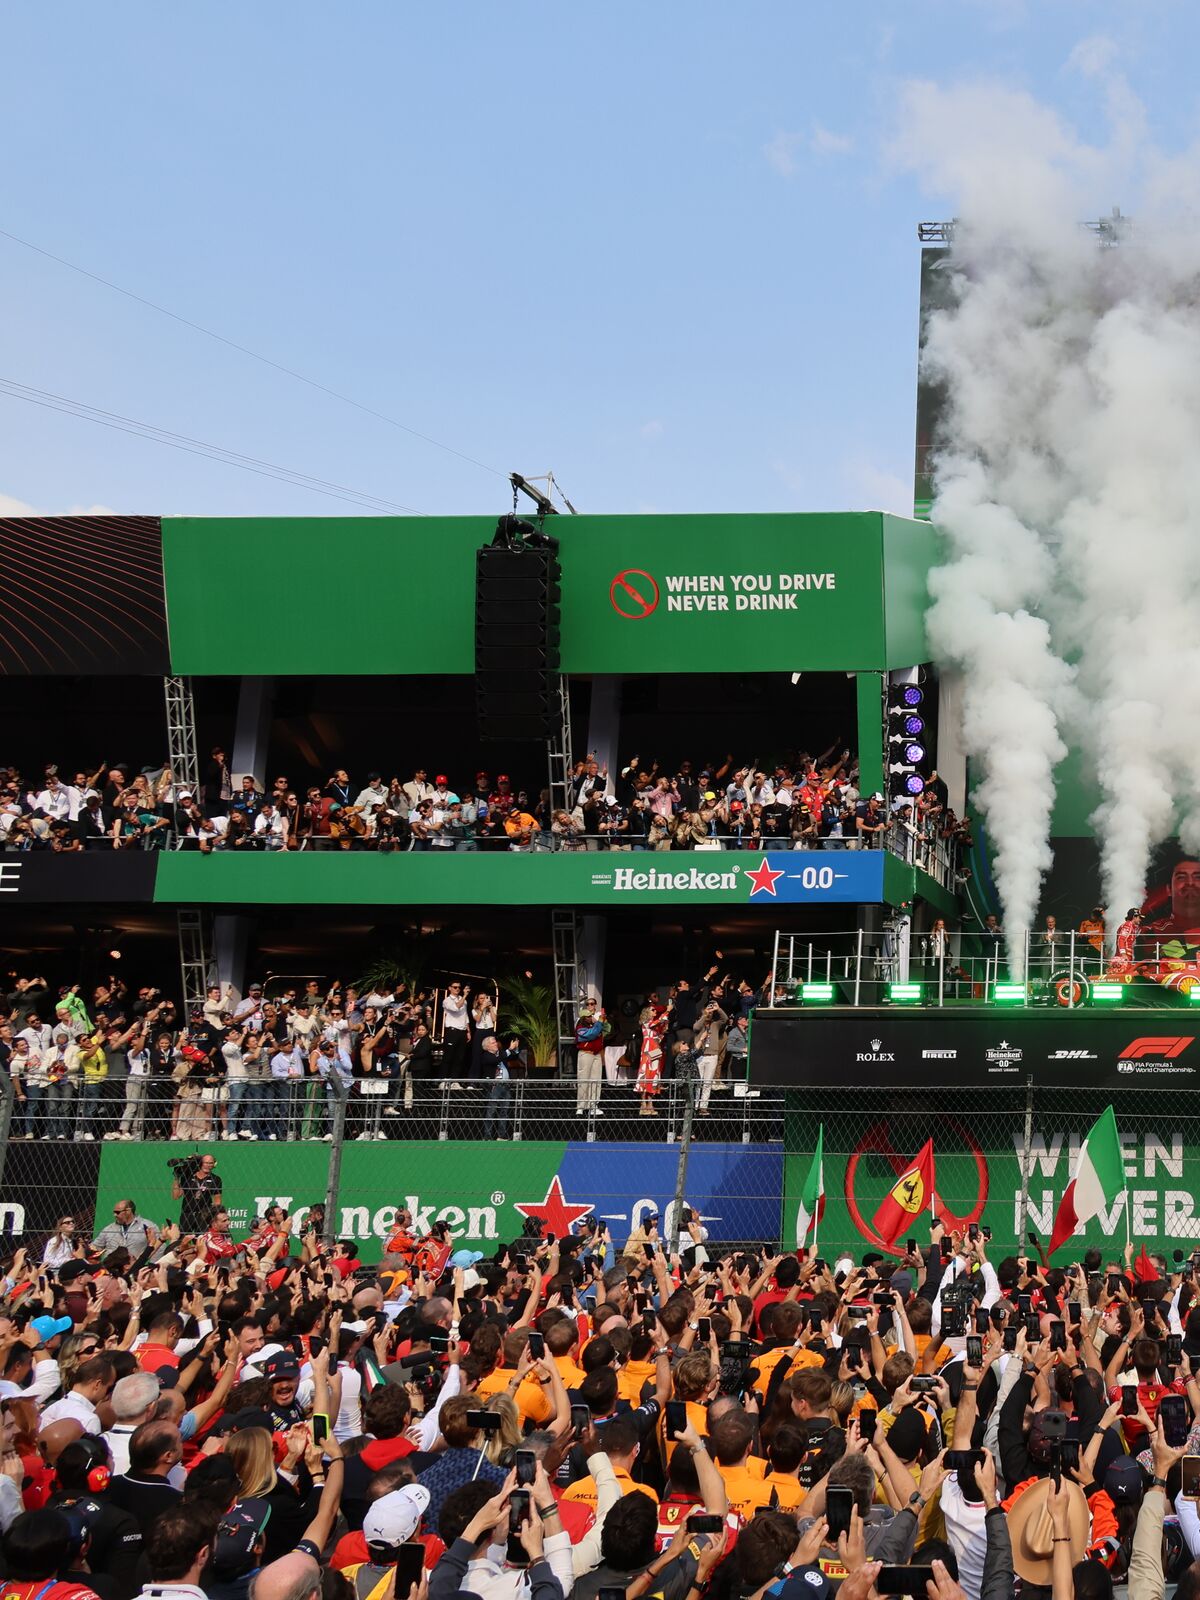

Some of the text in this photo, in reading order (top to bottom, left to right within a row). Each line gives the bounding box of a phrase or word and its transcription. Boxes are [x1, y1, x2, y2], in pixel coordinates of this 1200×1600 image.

[665, 573, 836, 592] WHEN YOU DRIVE
[667, 593, 799, 611] NEVER DRINK
[856, 1053, 895, 1062] ROLEX
[922, 1050, 957, 1059] PIRELLI
[1055, 1050, 1091, 1059] DHL
[1118, 1062, 1134, 1072] FIA
[1014, 1190, 1200, 1237] NVER
[122, 1533, 143, 1543] DOCTOR
